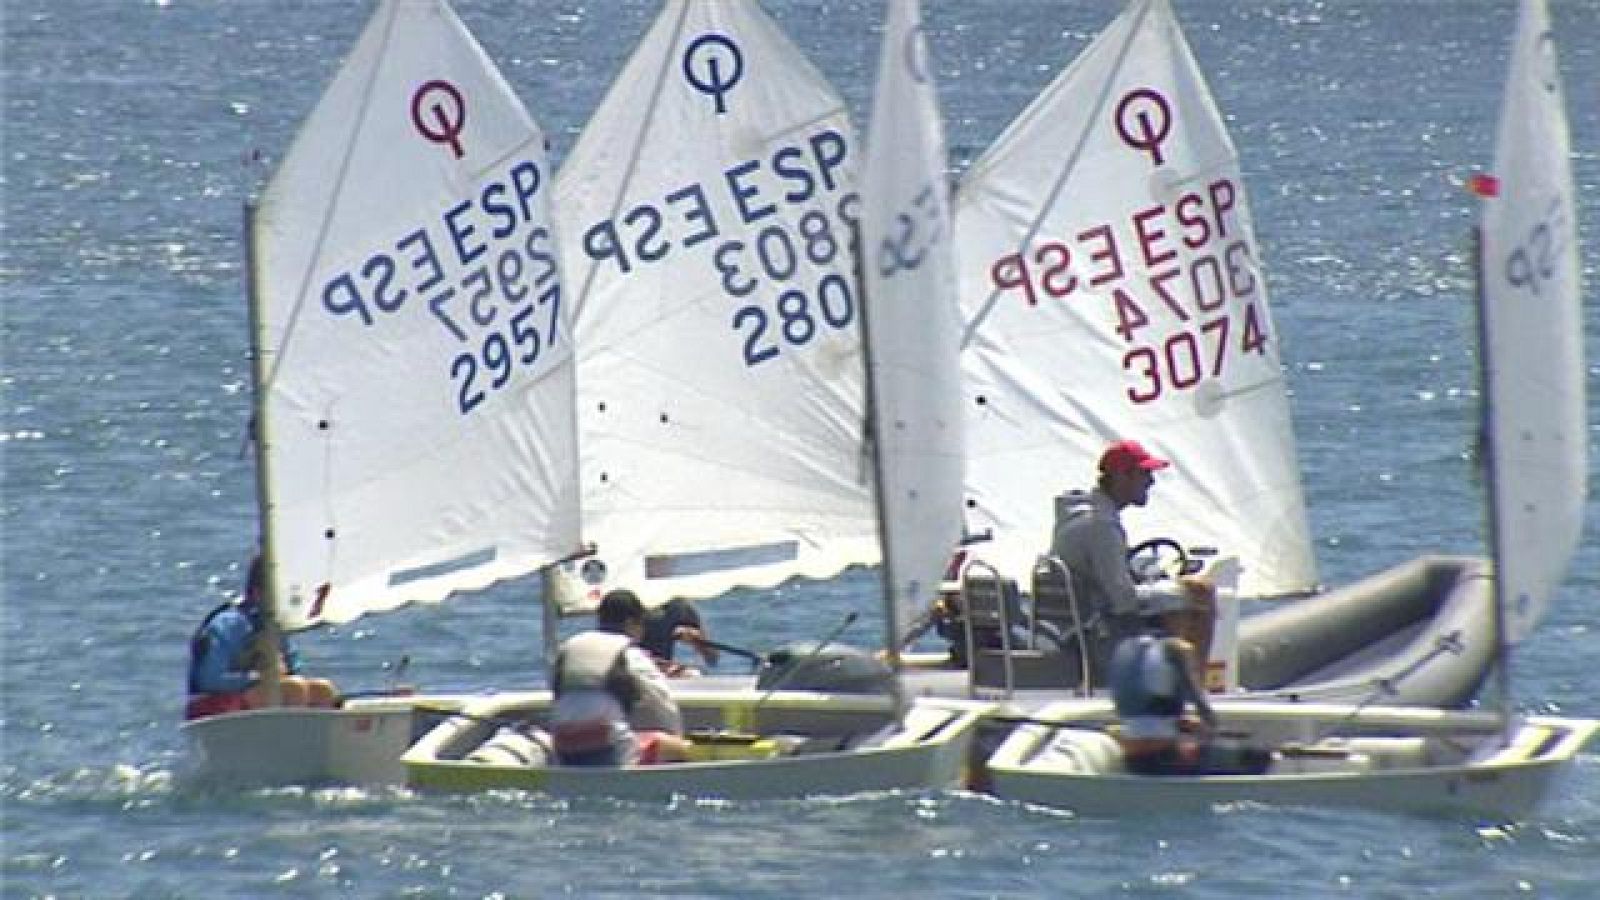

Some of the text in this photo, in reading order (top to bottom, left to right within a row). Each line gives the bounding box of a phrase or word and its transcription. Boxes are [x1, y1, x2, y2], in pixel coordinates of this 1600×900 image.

[443, 161, 541, 265] ESP
[724, 131, 846, 224] ESP
[1133, 180, 1235, 267] ESP
[451, 283, 560, 414] 2957
[1123, 302, 1265, 403] 3074
